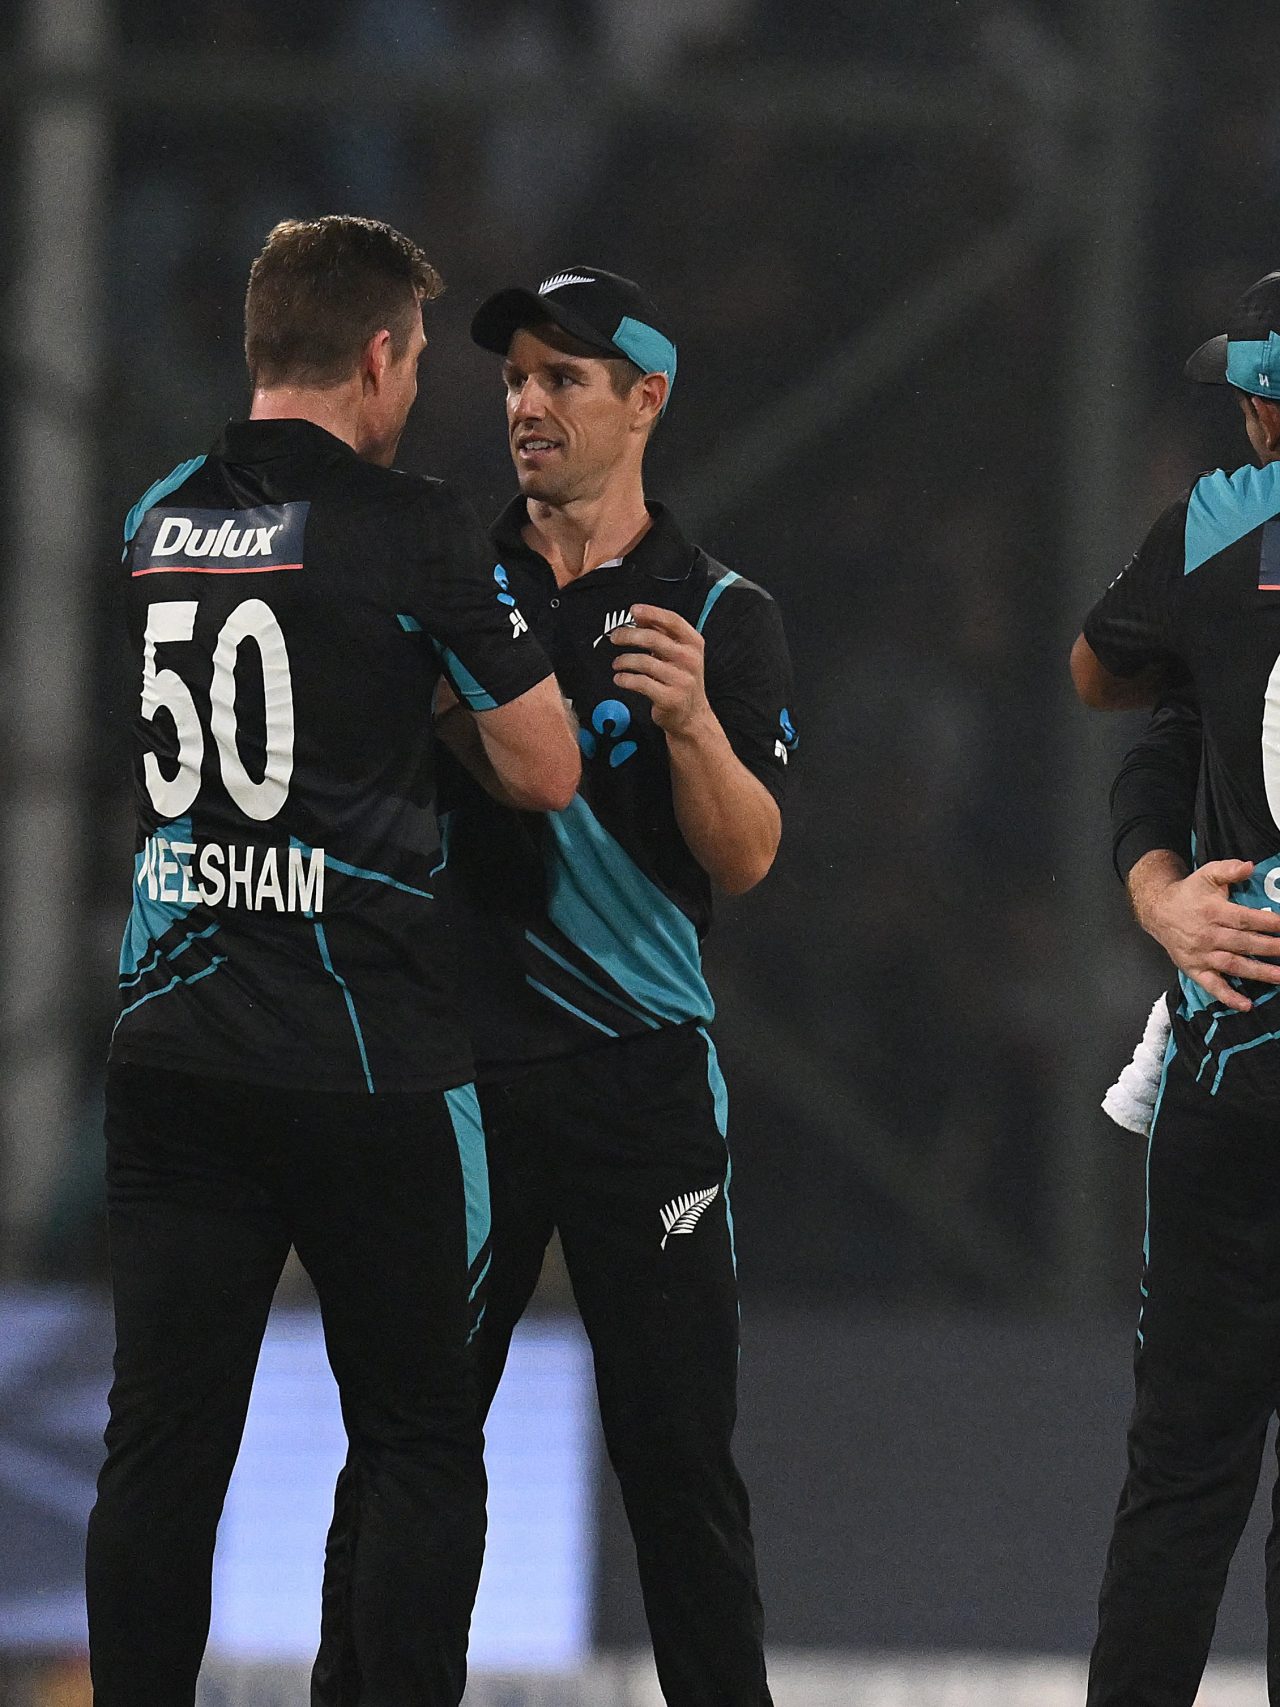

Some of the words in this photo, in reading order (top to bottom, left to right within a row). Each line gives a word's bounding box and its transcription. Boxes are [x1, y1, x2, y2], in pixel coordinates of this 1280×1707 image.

[151, 517, 279, 559] Dulux
[140, 598, 296, 822] 50
[137, 836, 326, 913] NEESHAM
